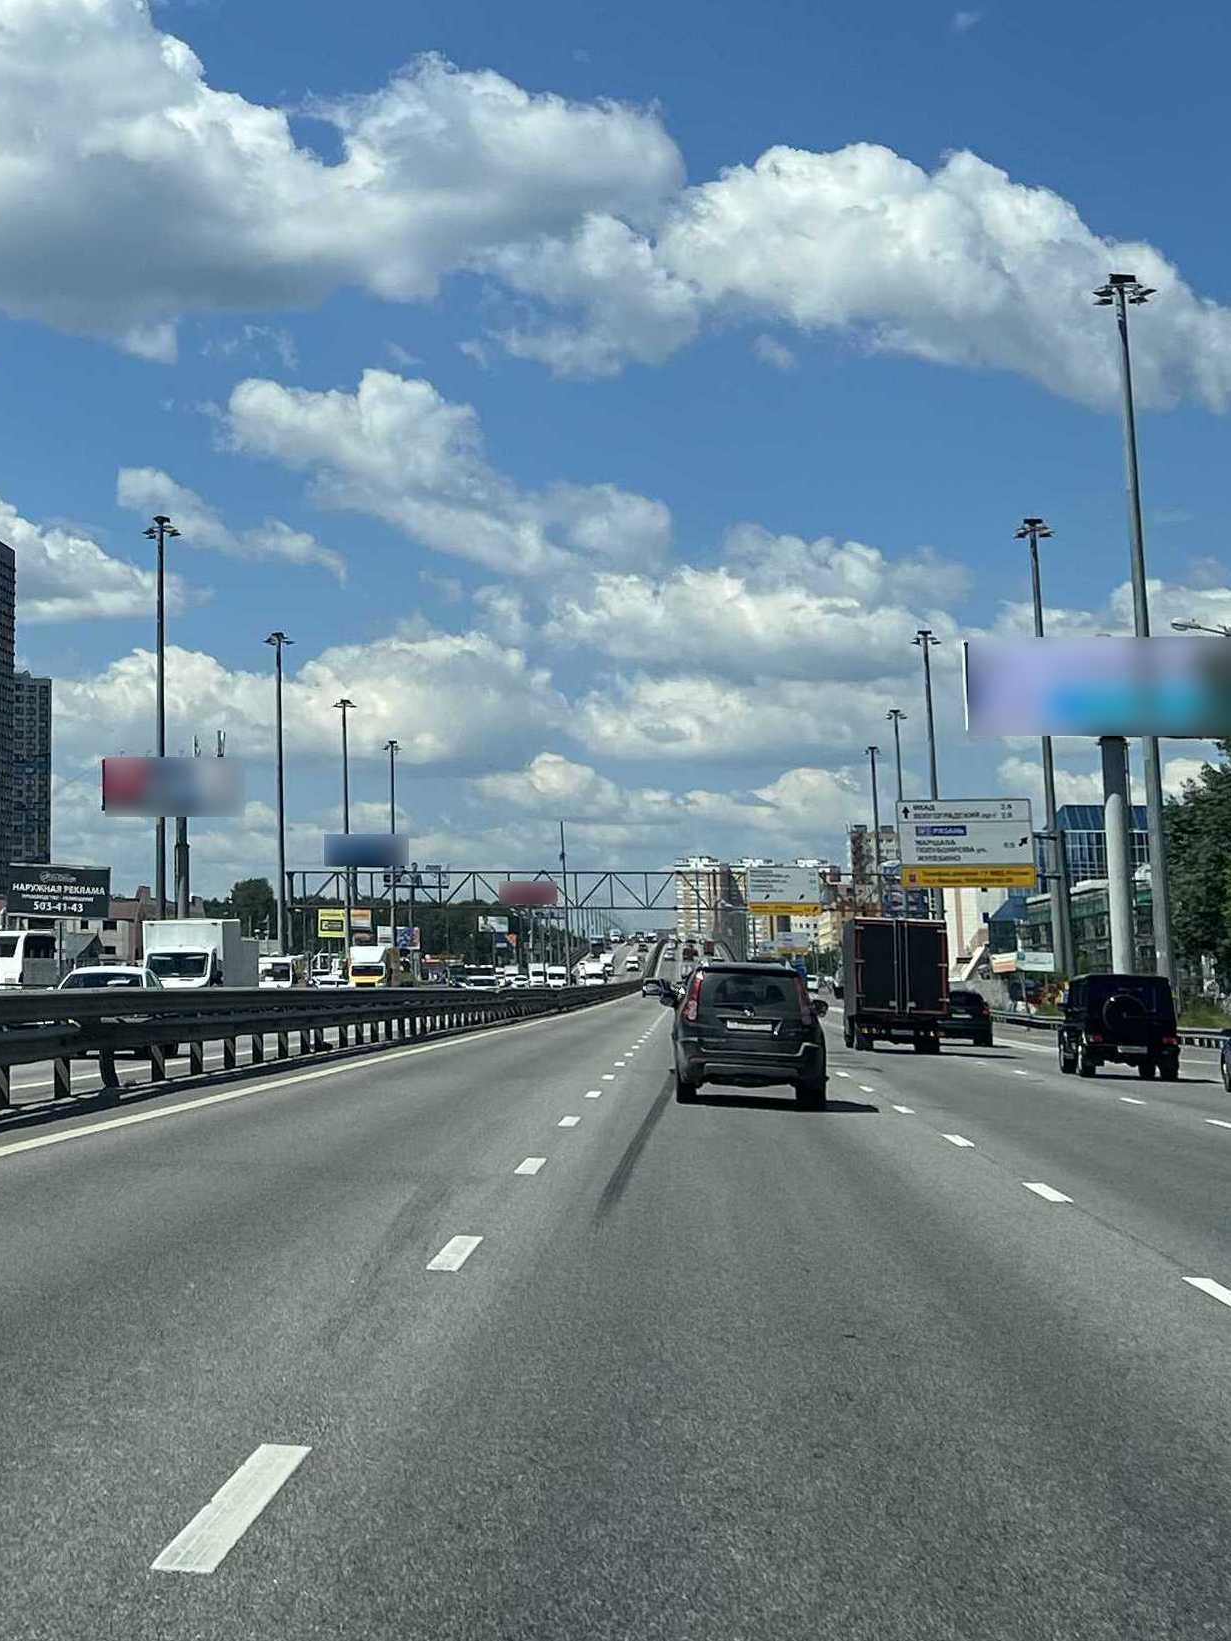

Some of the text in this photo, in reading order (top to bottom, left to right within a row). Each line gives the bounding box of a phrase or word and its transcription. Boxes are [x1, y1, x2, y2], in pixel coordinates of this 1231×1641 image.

[12, 883, 106, 896] НАРУЖНАЯ РЕКЛАМА
[33, 901, 84, 913] 503-41-43
